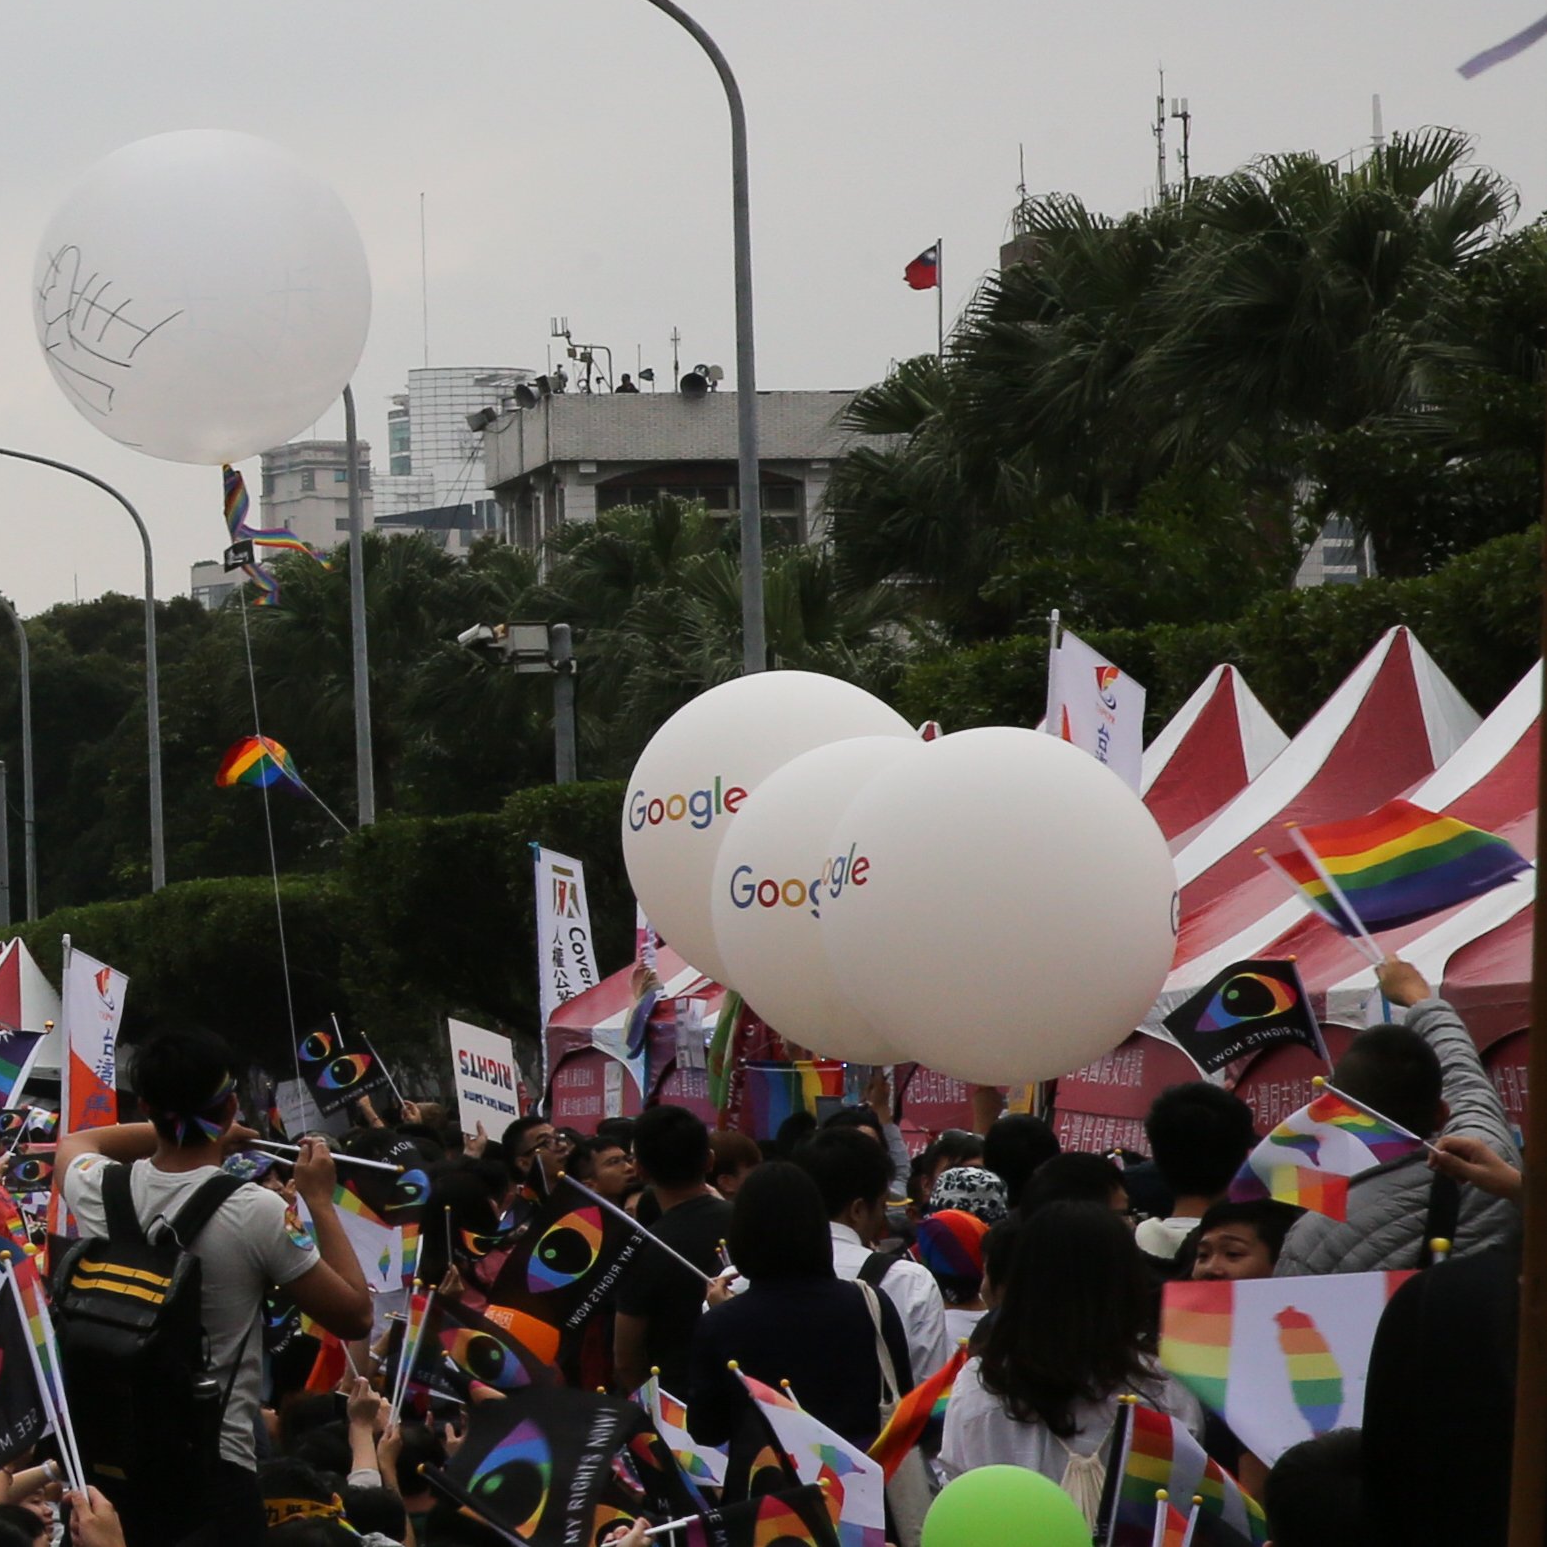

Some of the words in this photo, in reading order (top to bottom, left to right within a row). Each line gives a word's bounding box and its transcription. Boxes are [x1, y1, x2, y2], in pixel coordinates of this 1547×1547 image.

[629, 775, 748, 832] Google
[730, 864, 822, 920] Goo
[458, 1049, 514, 1092] RIGHTS
[566, 1453, 606, 1512] RIGHTS
[563, 1517, 581, 1545] MY
